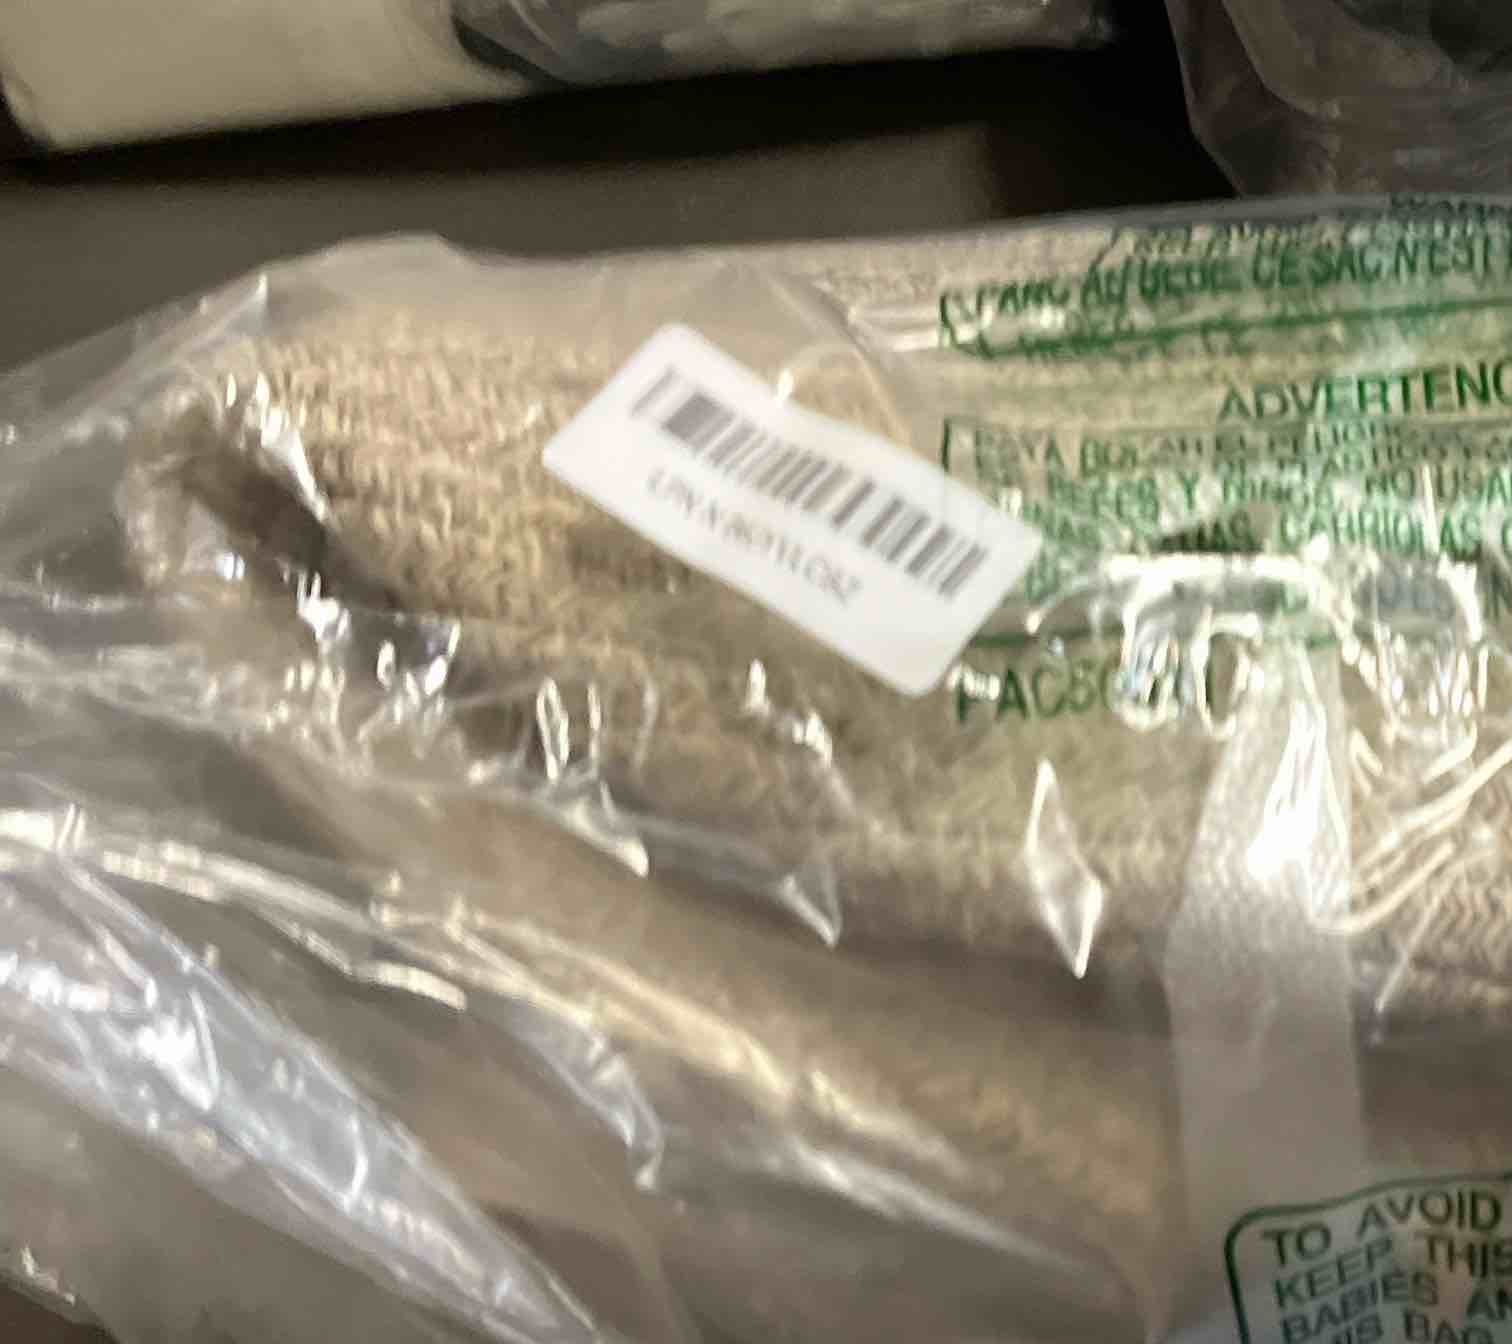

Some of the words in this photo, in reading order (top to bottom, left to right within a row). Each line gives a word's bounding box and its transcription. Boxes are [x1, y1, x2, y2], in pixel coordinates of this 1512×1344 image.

[1261, 1221, 1333, 1268] TO
[1357, 1187, 1502, 1239] AVOID
[1273, 1235, 1394, 1309] KEEP
